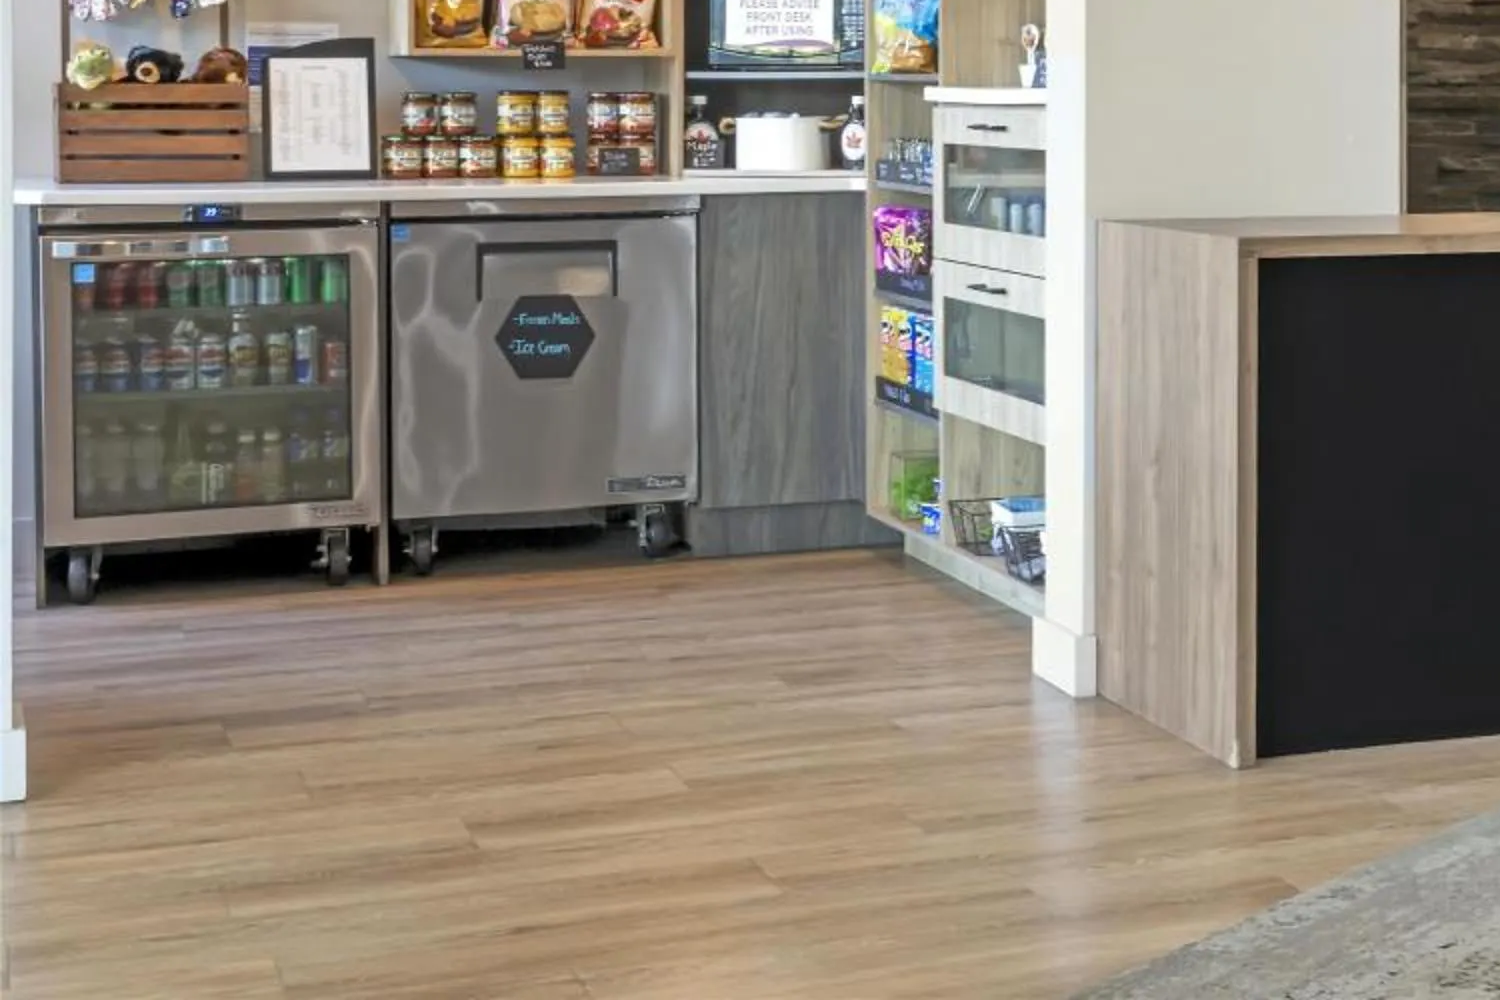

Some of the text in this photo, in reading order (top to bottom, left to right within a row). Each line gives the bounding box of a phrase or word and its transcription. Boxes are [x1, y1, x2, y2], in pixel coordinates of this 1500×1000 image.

[746, 11, 814, 23] FRONT DESK
[745, 25, 814, 37] AFTER USING
